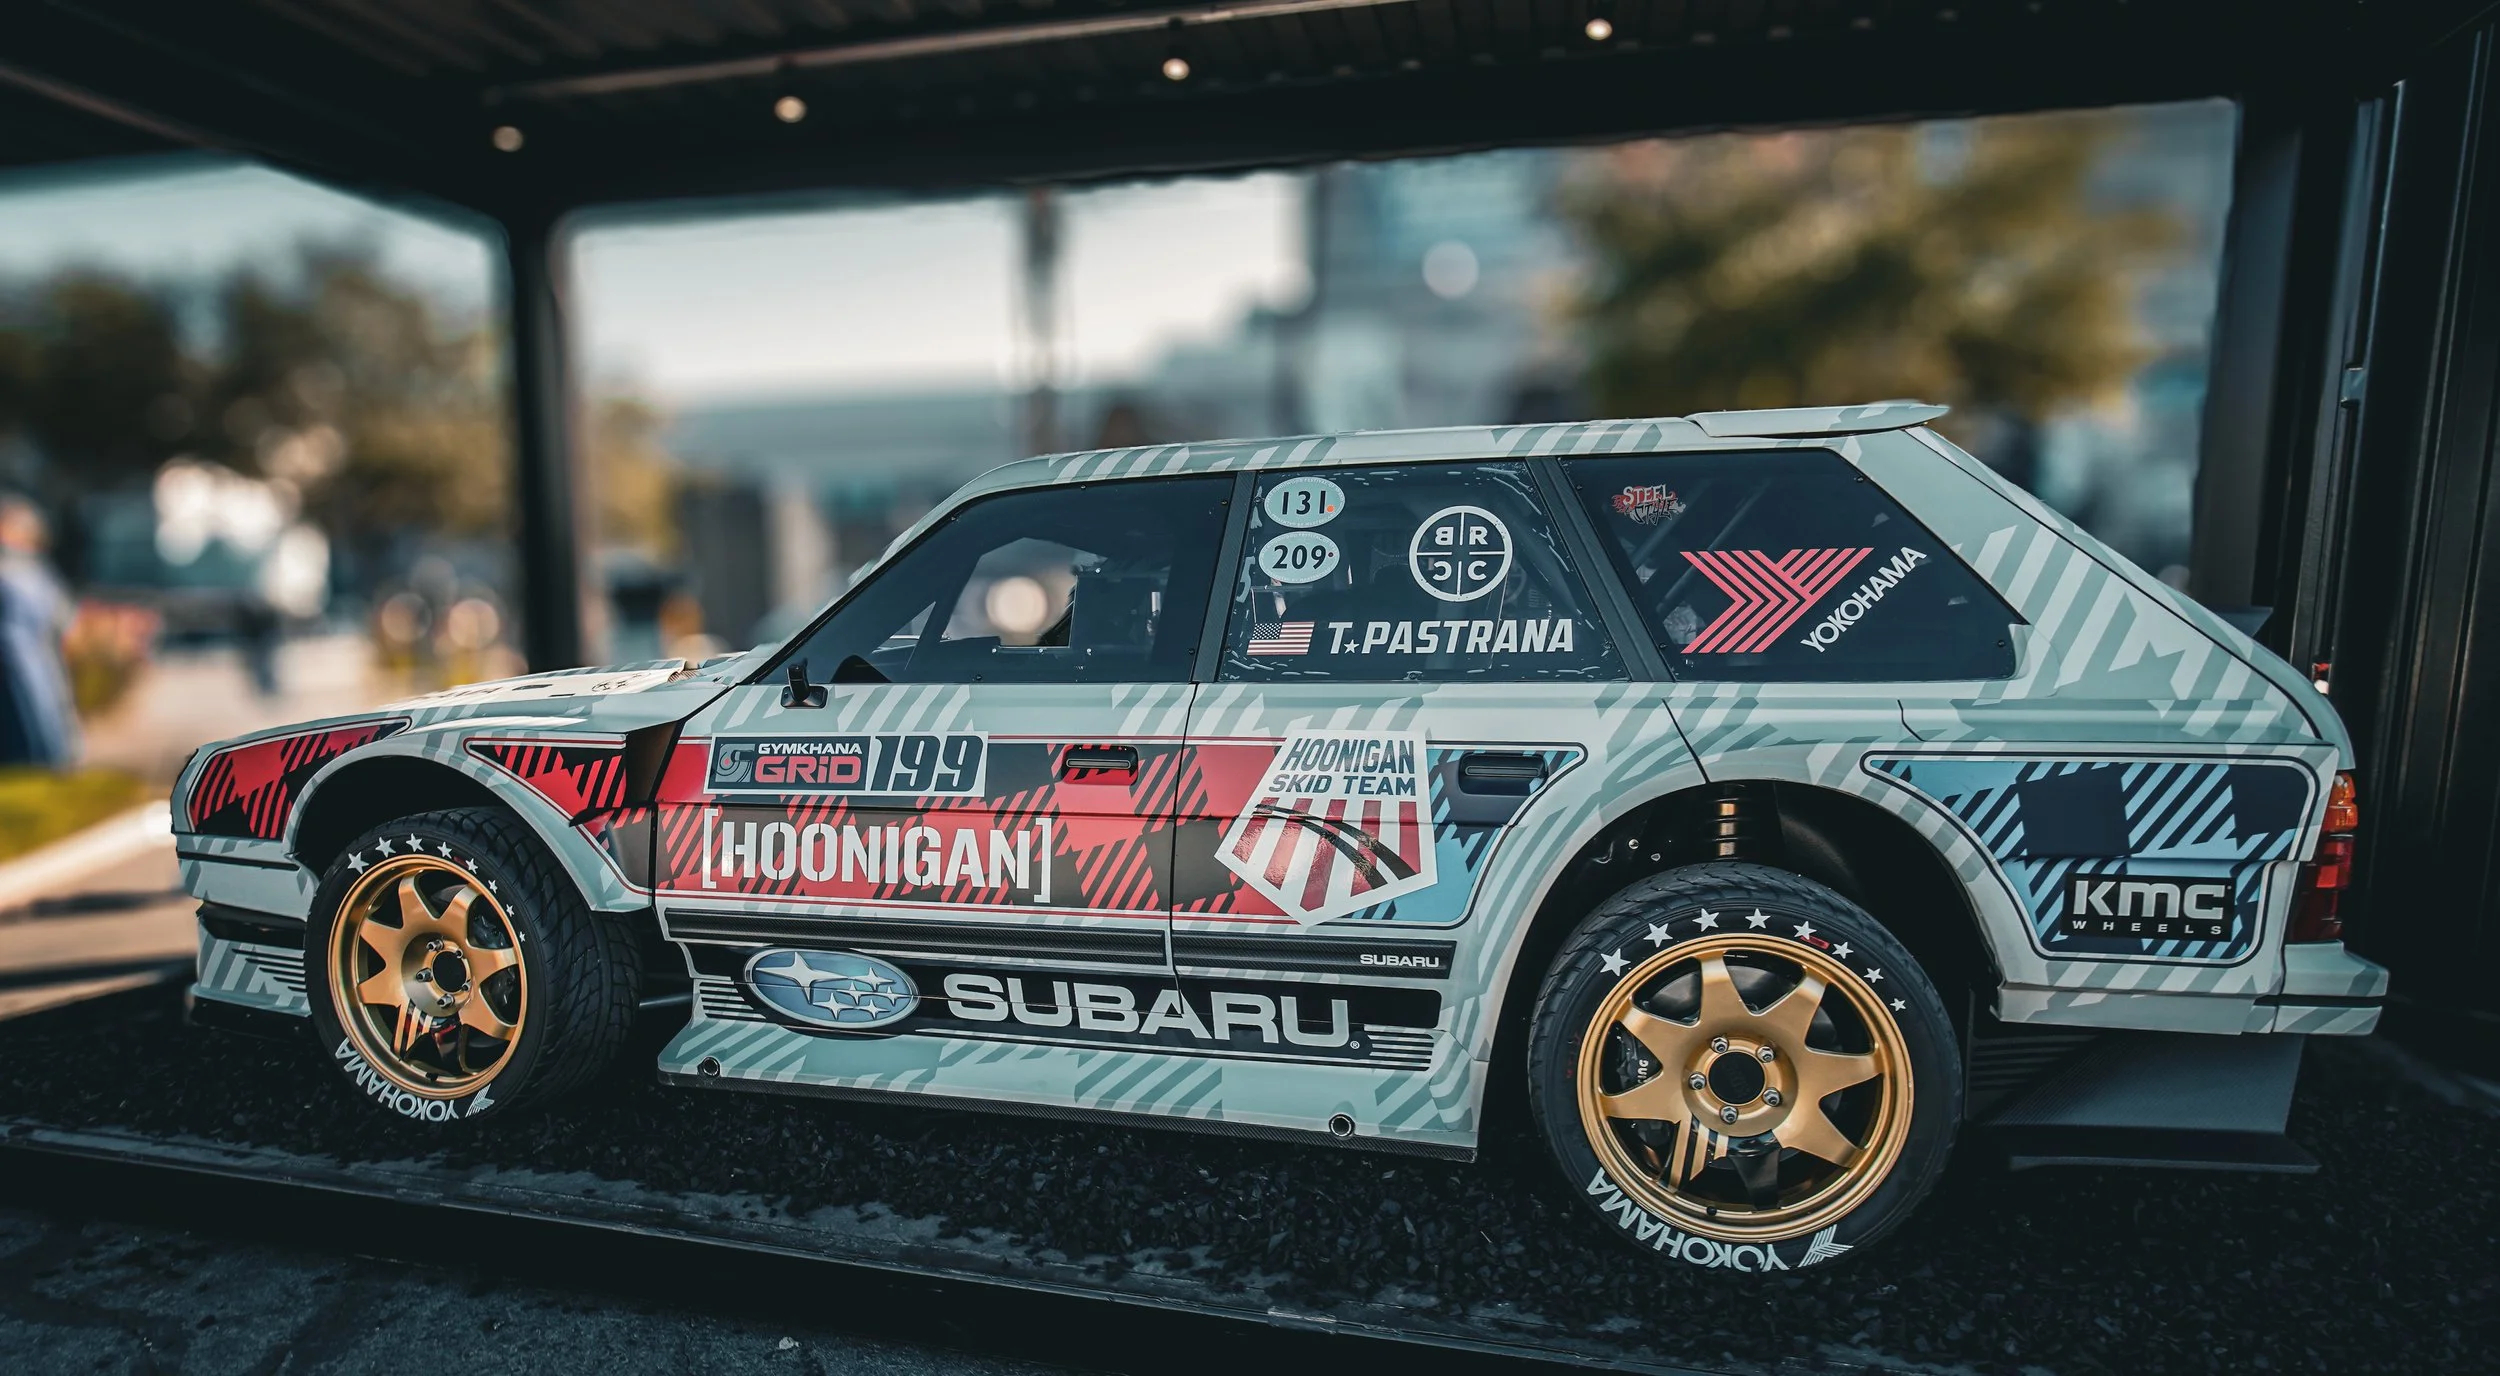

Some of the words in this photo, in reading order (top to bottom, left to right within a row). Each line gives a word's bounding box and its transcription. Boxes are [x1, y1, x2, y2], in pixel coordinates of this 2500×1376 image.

[1282, 490, 1326, 515] 131
[1623, 484, 1674, 506] STEEL
[1272, 545, 1326, 570] 209
[1801, 546, 1926, 653] YOKOHAMA
[758, 743, 863, 755] GYMKHANA
[1280, 737, 1416, 774] HOONIGAN
[870, 735, 984, 793] 199
[1268, 774, 1333, 794] SKID
[1343, 775, 1417, 796] TEAM
[2072, 920, 2223, 935] WHEELS
[1360, 953, 1440, 968] SUBARU
[335, 1036, 460, 1122] YOKOHAMA
[1586, 1166, 1790, 1273] YOKOHAMA
